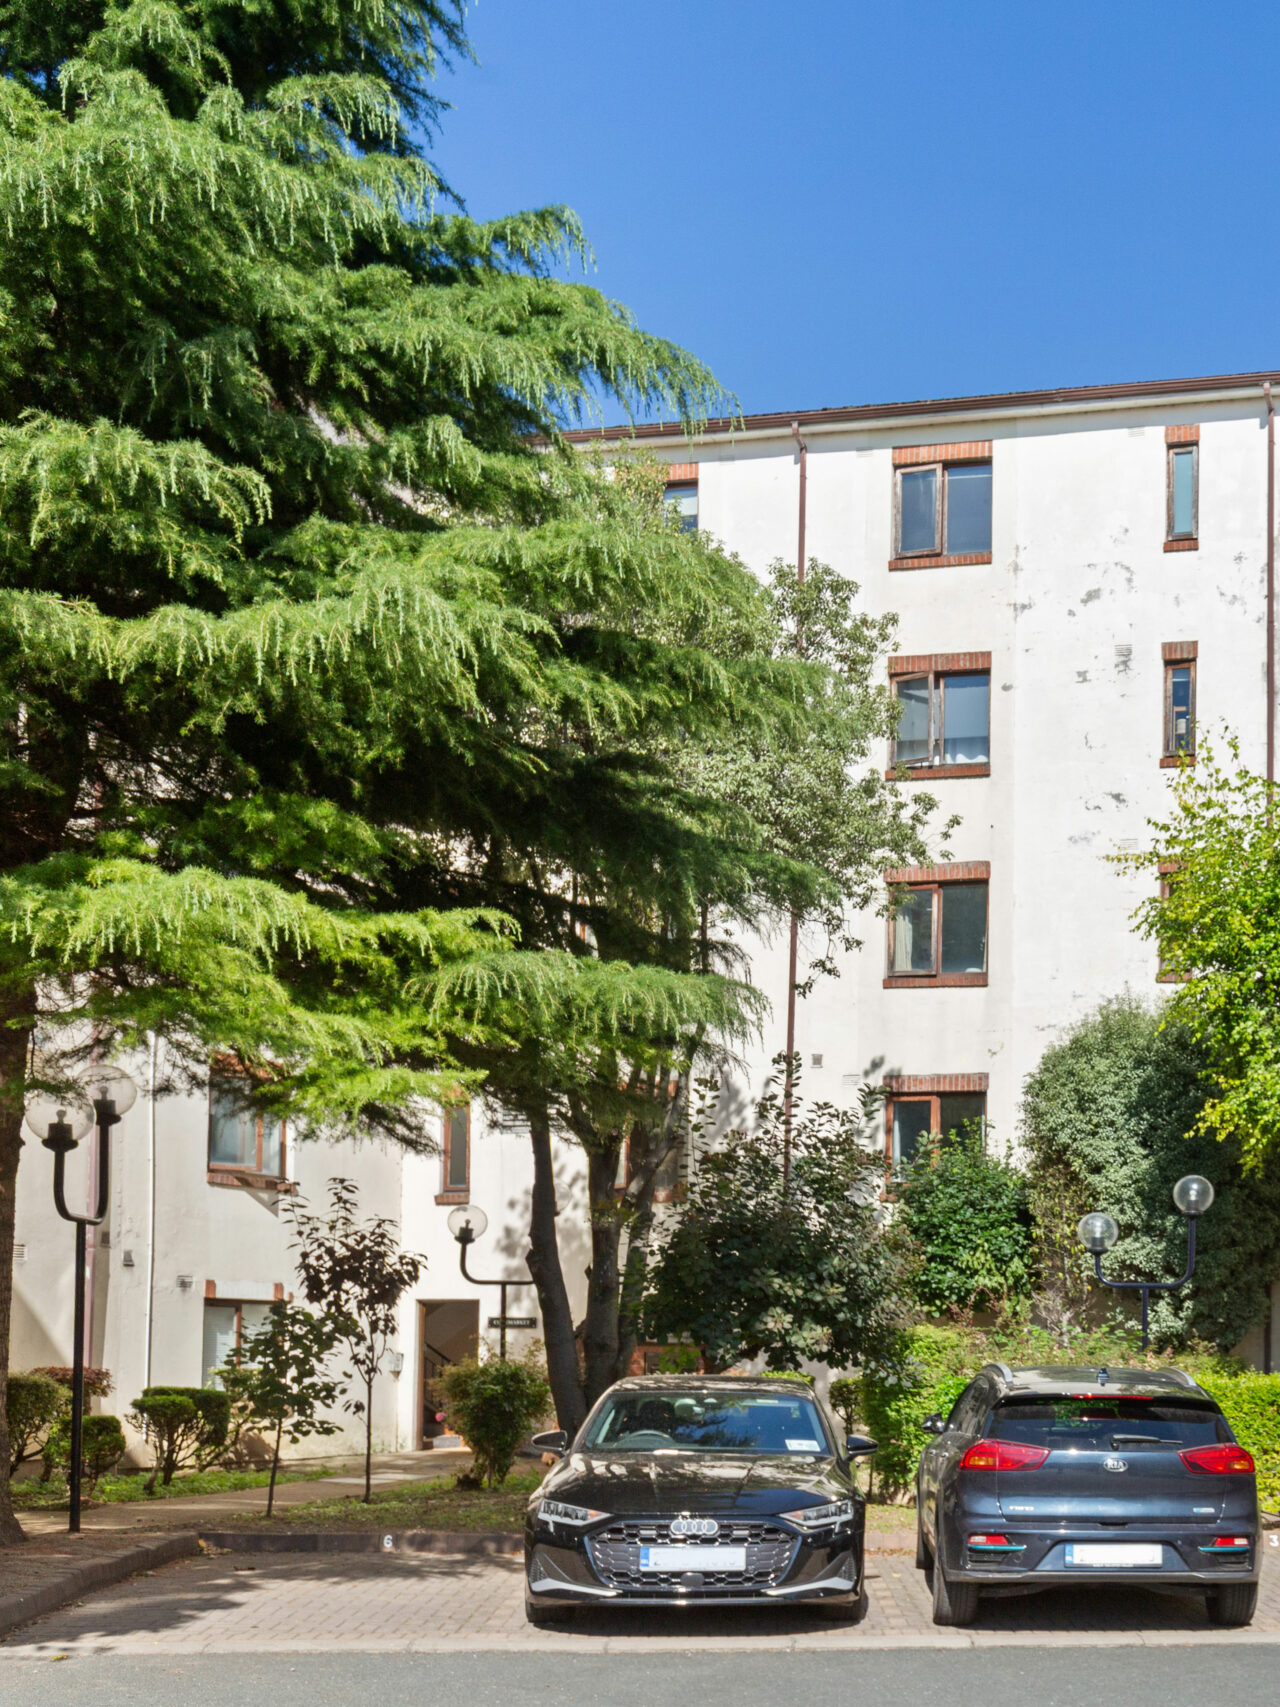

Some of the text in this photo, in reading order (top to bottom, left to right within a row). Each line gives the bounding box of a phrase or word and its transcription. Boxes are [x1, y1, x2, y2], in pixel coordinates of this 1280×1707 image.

[1107, 1459, 1125, 1469] KIA
[383, 1534, 393, 1547] 6
[1268, 1534, 1279, 1547] 3
